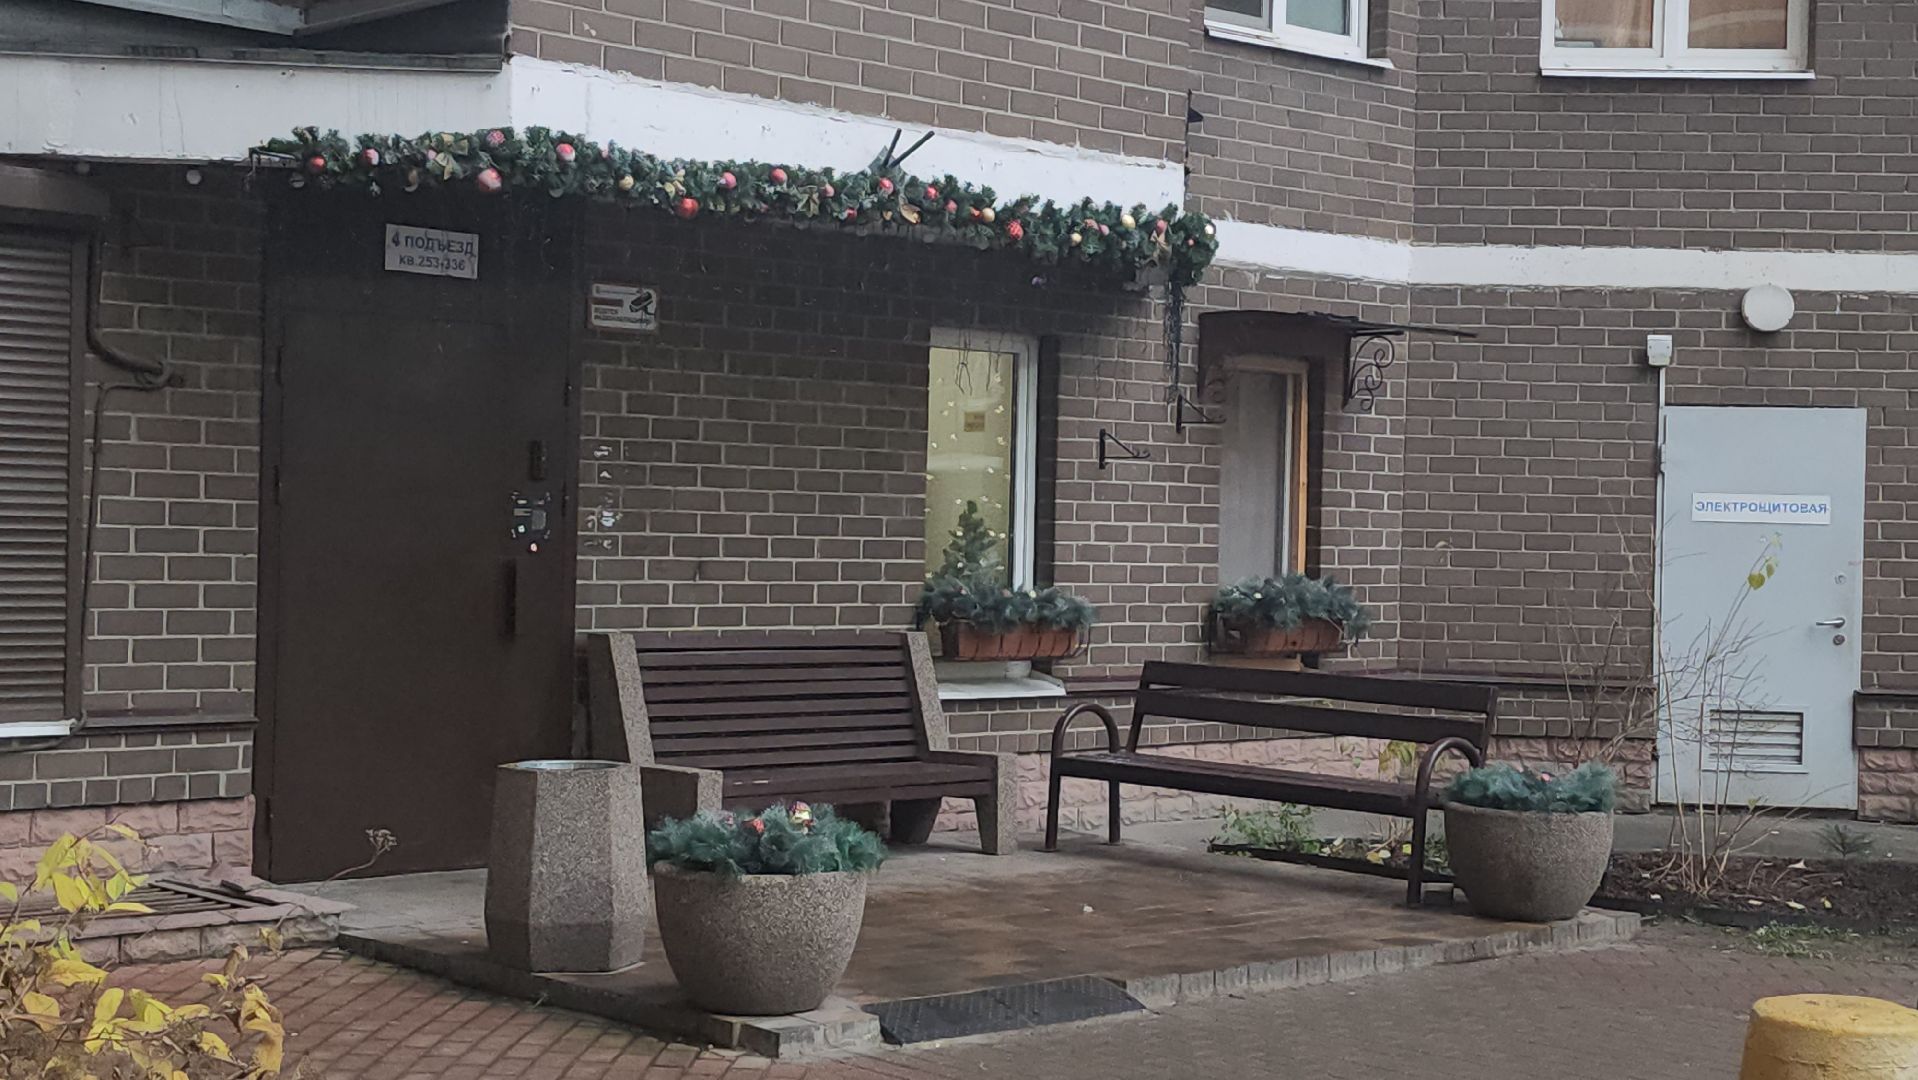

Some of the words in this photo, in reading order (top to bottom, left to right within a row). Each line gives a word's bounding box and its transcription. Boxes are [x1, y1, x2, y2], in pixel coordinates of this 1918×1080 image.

[391, 231, 401, 247] 4
[404, 235, 476, 257] ПОДЪЕЗД
[1695, 501, 1827, 514] ЭЛЕКТРОЩИТОВАЯ
